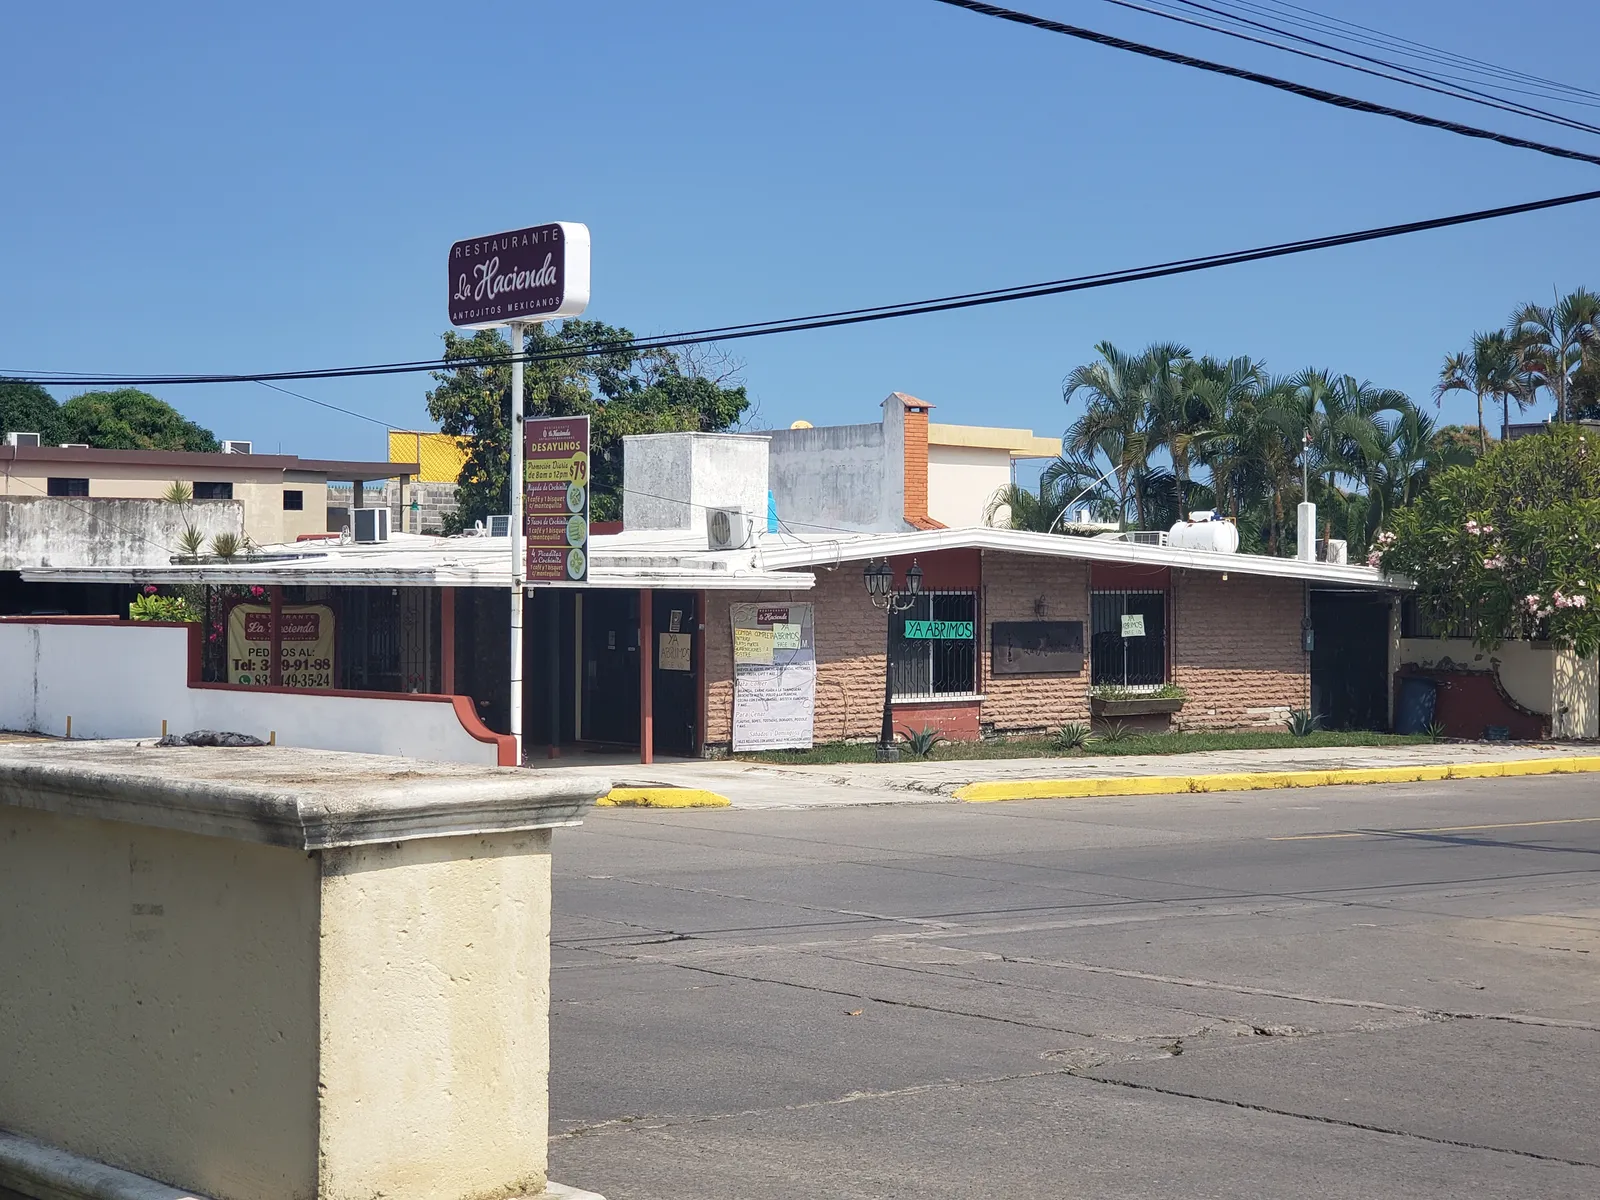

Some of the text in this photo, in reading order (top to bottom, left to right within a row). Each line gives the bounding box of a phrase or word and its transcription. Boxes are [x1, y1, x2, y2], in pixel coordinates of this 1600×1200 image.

[455, 228, 559, 258] RESTAURANTE
[454, 252, 557, 301] La Hacienda
[453, 296, 560, 320] ANTOJITOS MEXICANOS
[532, 441, 581, 452] DESAYUNOS
[570, 461, 586, 480] $79
[247, 622, 265, 633] La
[908, 621, 972, 638] YA ABRIMOS
[668, 634, 679, 645] YA
[248, 648, 315, 657] PEDOS AL:
[233, 659, 256, 671] Tel:
